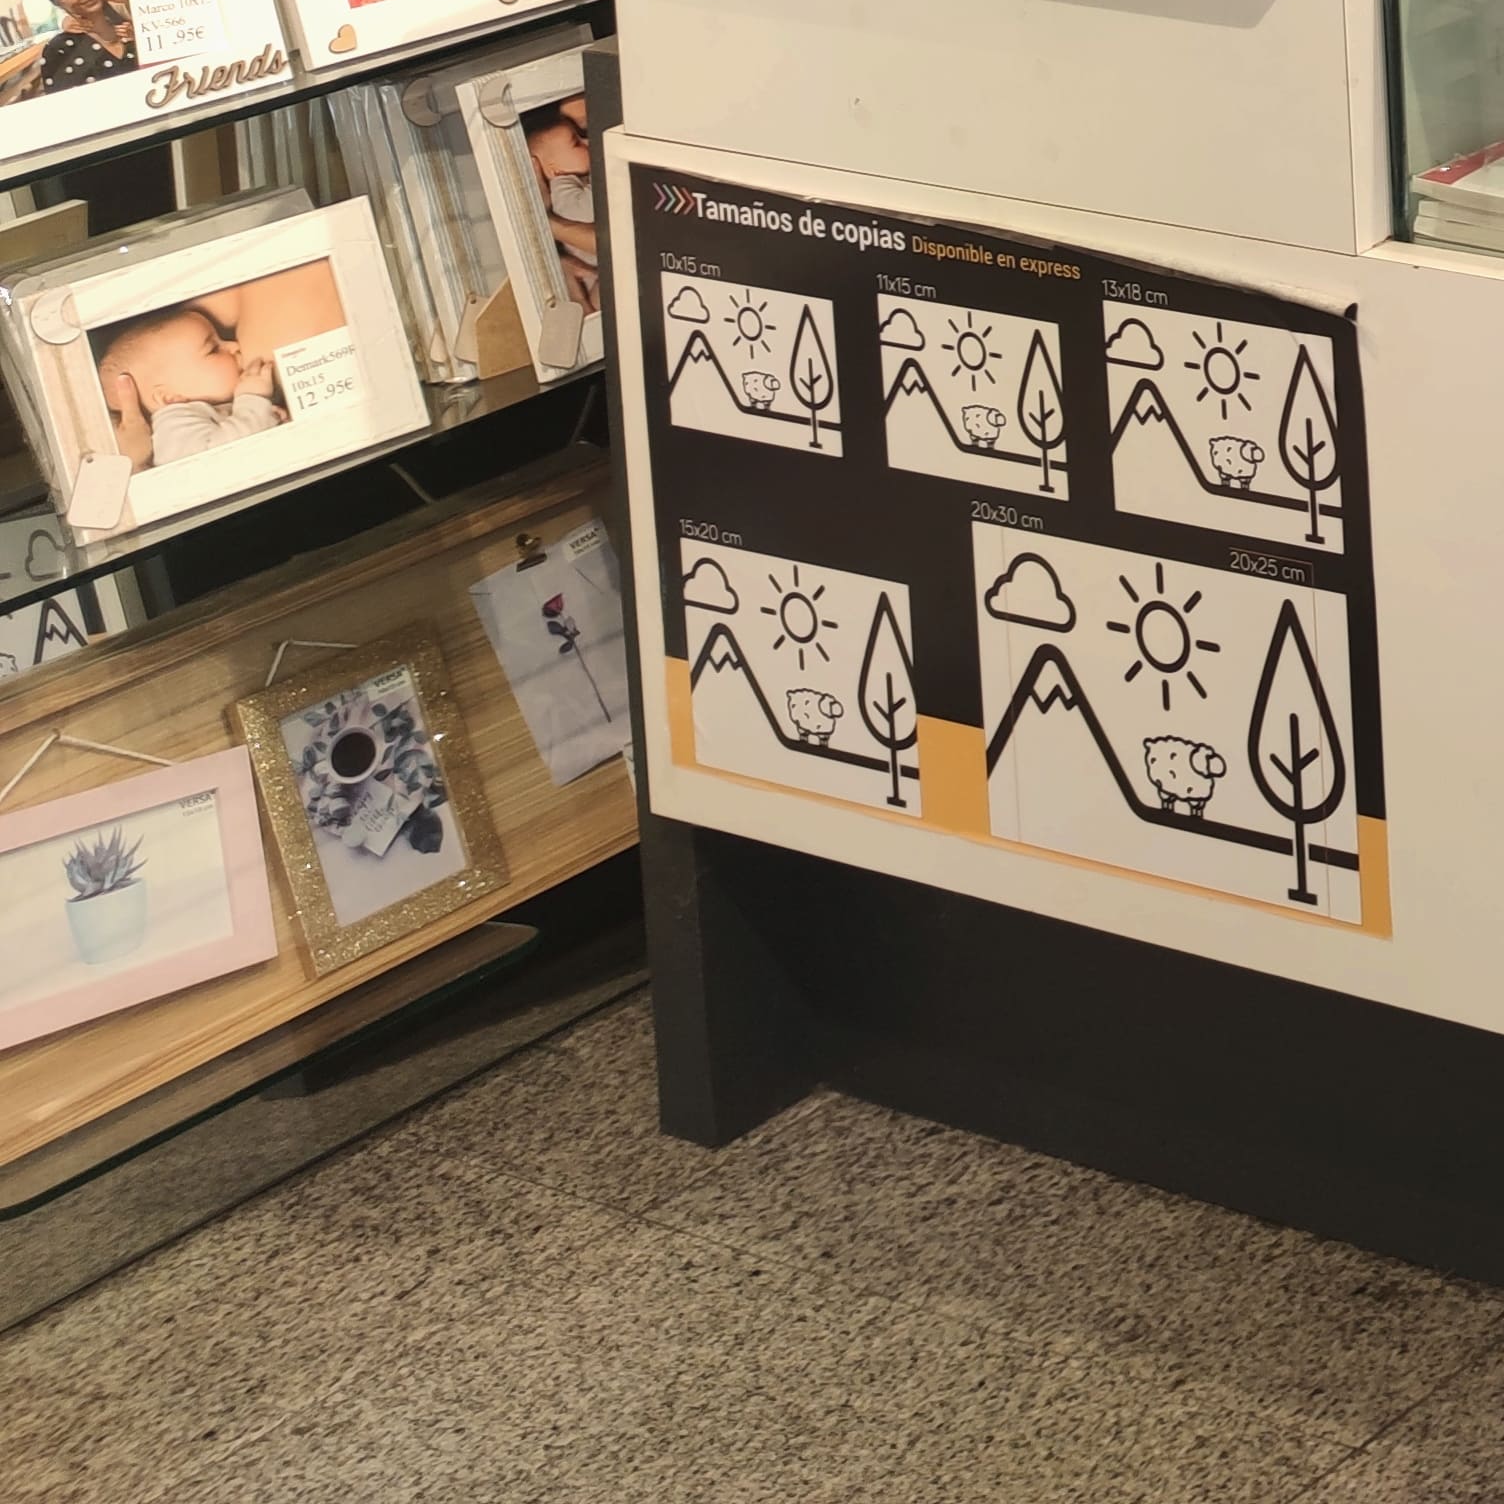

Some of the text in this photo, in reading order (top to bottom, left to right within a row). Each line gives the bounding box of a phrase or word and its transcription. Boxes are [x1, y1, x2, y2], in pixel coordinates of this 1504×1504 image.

[145, 44, 288, 108] Friends
[693, 190, 1081, 280] Tamaños de copias Disponible en express
[660, 252, 721, 277] 10x15 cm
[876, 274, 937, 299] 11x15 cm
[1101, 279, 1168, 306] 13x18 cm
[970, 500, 1044, 530] 20x30 cm
[679, 519, 743, 546] 15x20 cm
[1229, 551, 1305, 582] 20x25 cm
